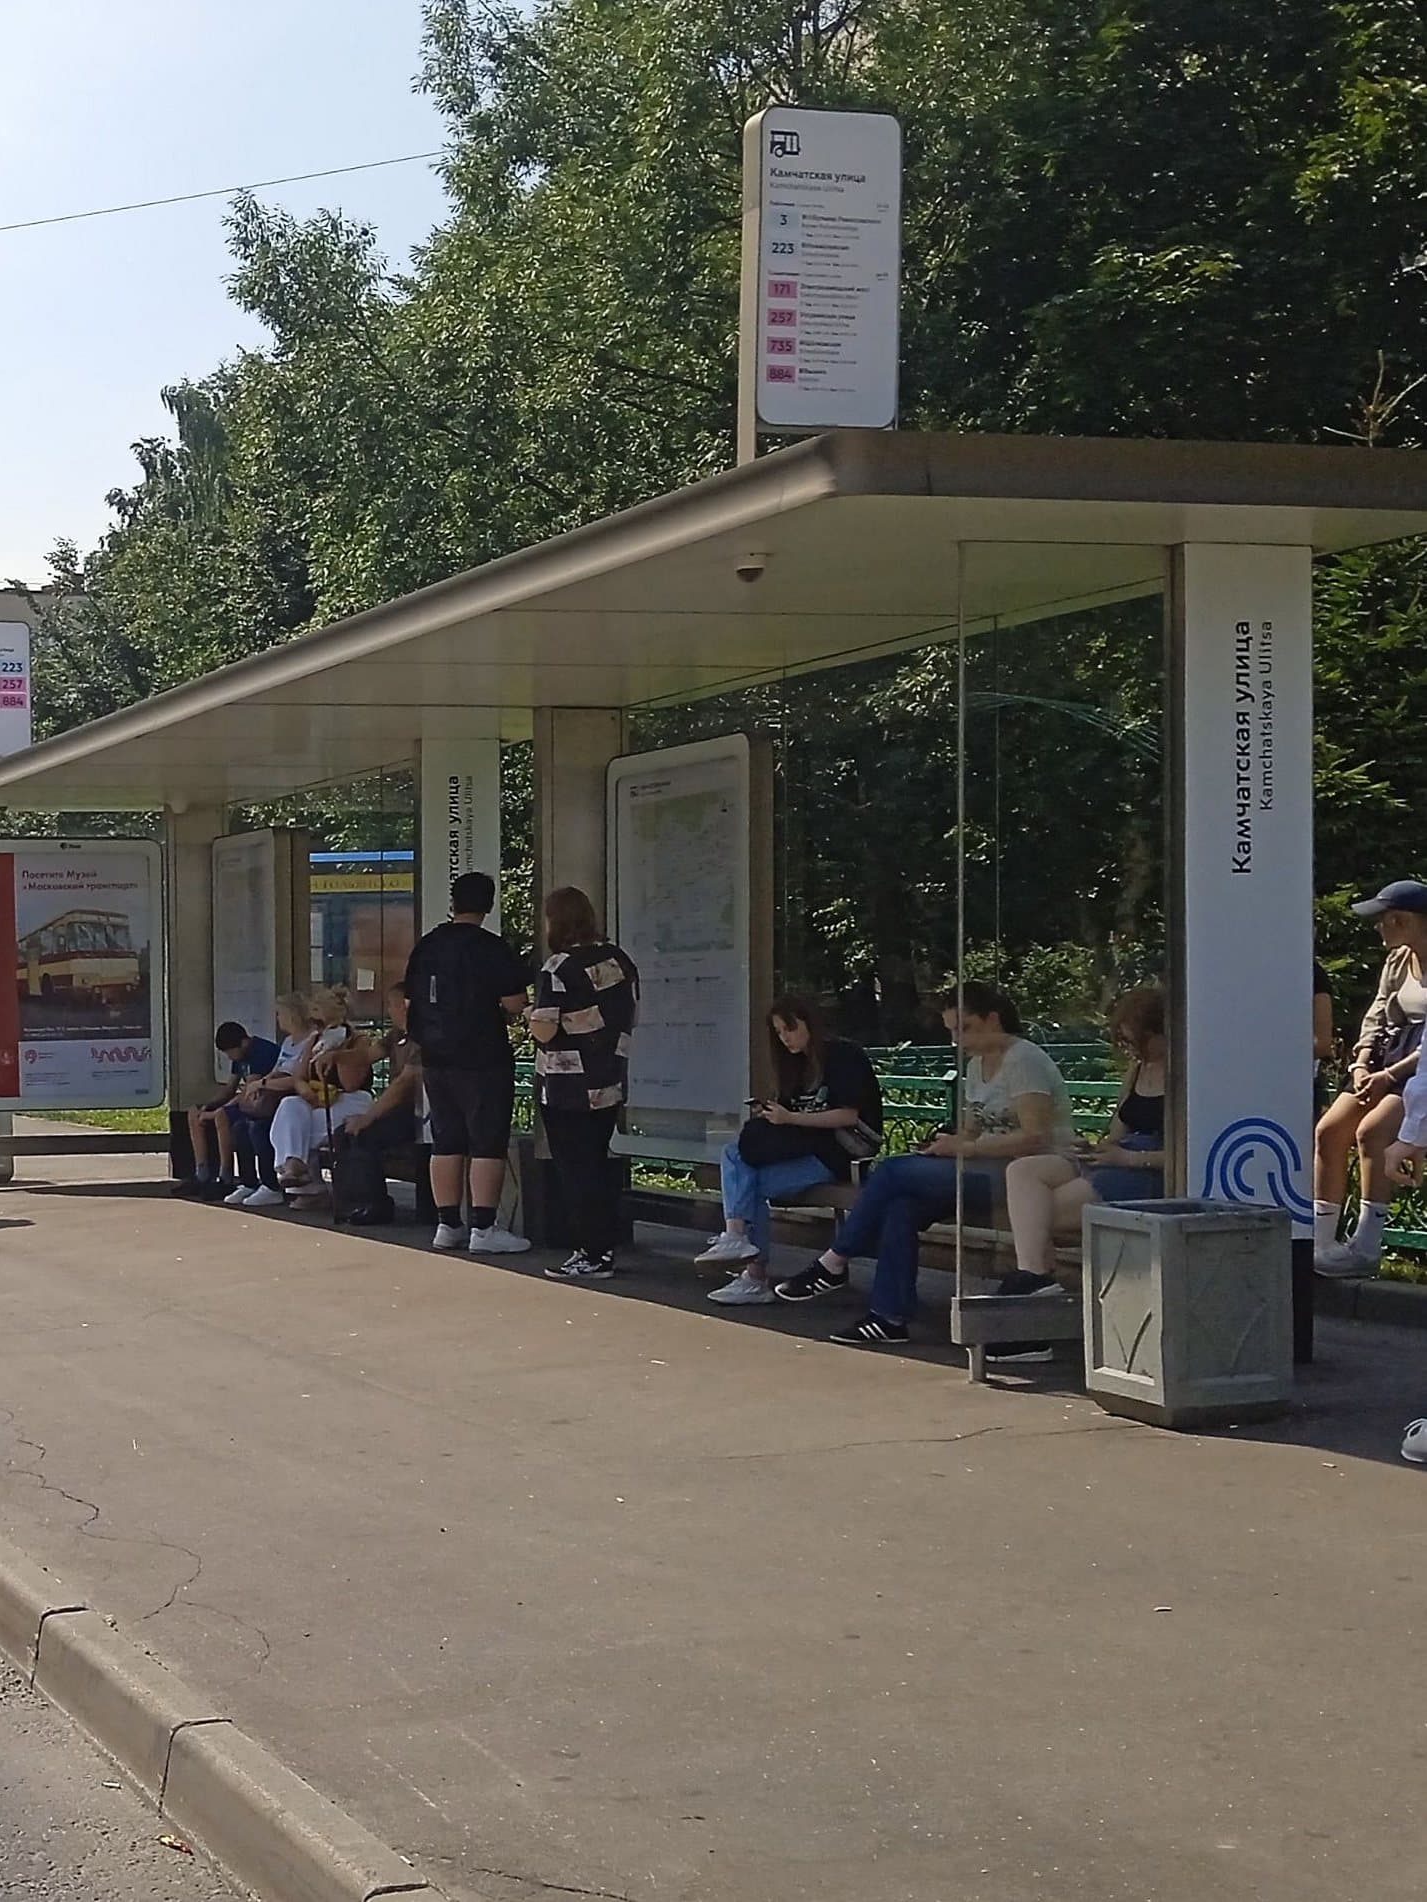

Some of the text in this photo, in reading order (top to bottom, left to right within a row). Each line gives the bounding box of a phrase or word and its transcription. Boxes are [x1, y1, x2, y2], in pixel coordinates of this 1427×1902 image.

[769, 168, 865, 184] Камчатская улица
[779, 214, 788, 226] 3
[771, 242, 795, 254] 223
[773, 283, 791, 295] 171
[770, 311, 793, 323] 257
[769, 340, 793, 351] 735
[768, 368, 792, 379] 884
[1, 662, 23, 673] 223
[2, 679, 23, 689] 257
[2, 696, 24, 706] 884
[1259, 620, 1277, 811] Kamchatskaya Ulitsa
[1231, 620, 1256, 875] Камчатская улица
[448, 775, 462, 824] улица
